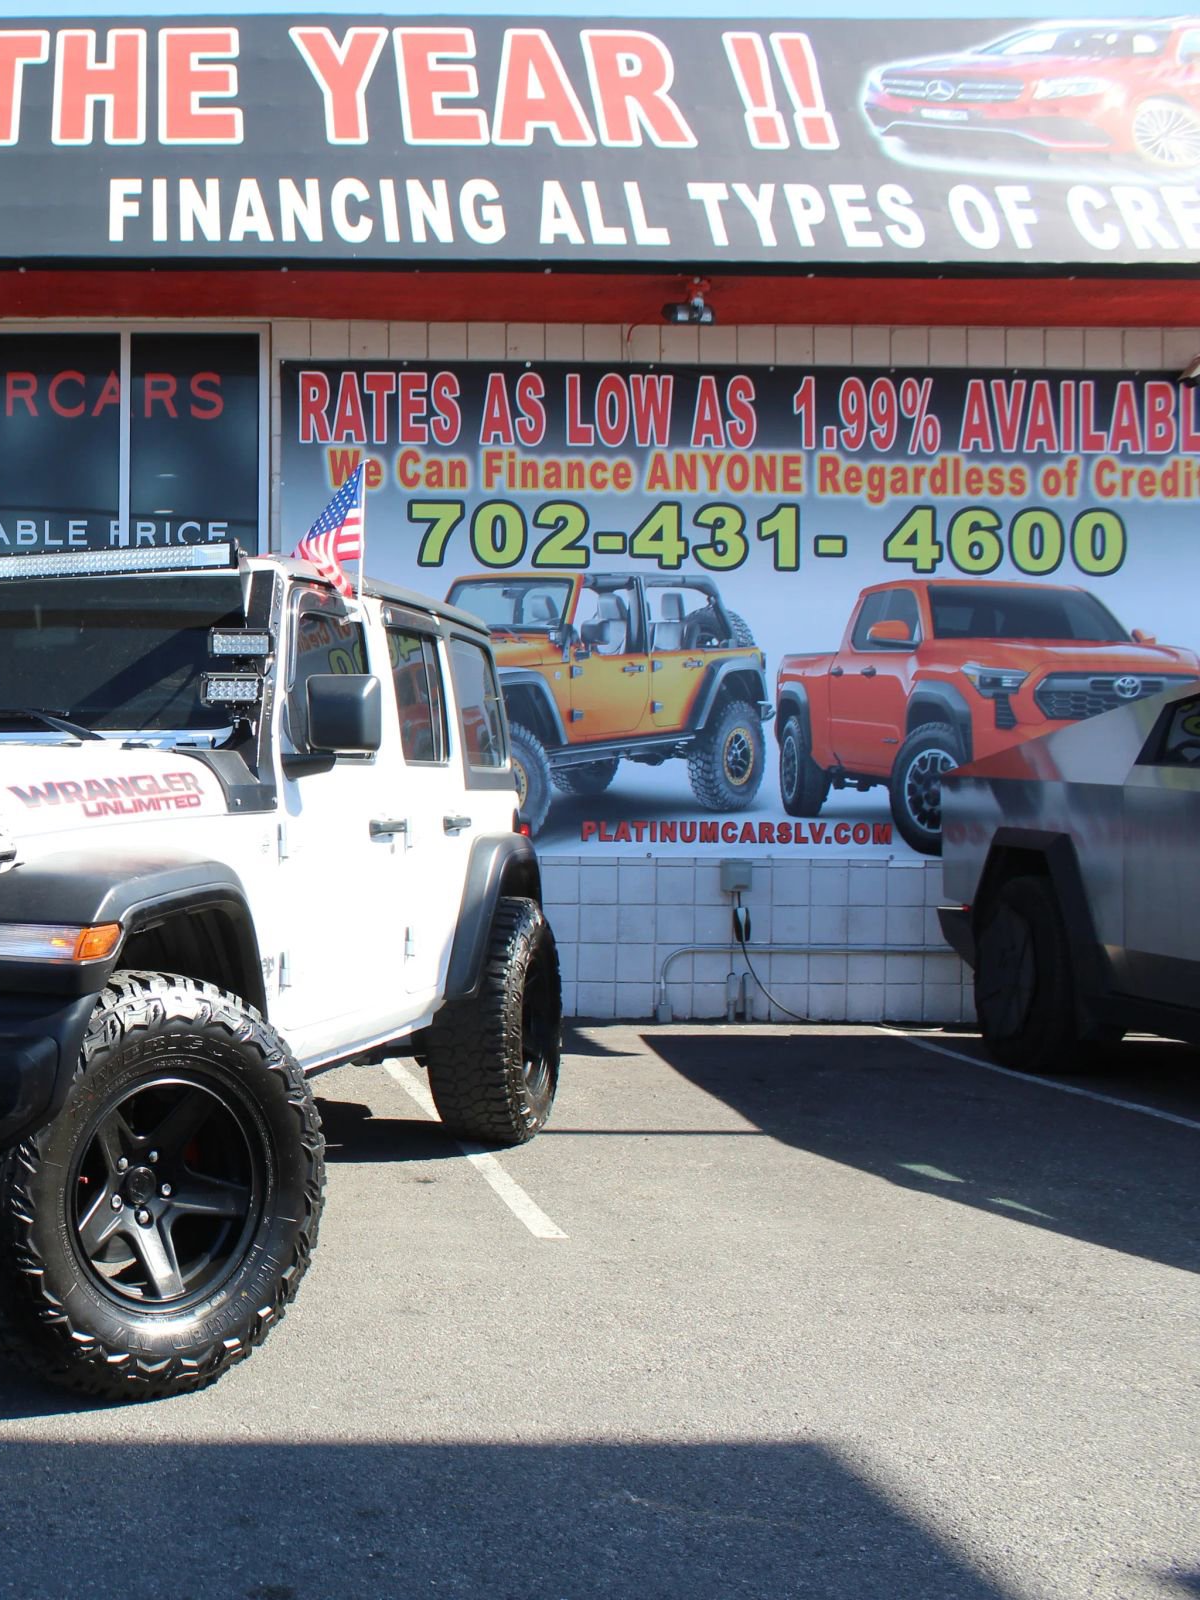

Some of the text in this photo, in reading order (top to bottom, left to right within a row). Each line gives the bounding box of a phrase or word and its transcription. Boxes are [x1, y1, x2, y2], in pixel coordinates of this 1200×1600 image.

[288, 26, 698, 148] YEAR
[721, 31, 841, 151] !!
[109, 178, 1200, 250] FINANCING ALL TYPES OF CRE
[299, 371, 1200, 454] RATES AS LOW AS 1.99% AVAILABL
[328, 449, 1200, 504] We Can Finance ANYONE Regardless of Credi
[407, 499, 1129, 577] 702-431- 4600
[7, 771, 205, 818] WRANGLER UNLIMITED
[580, 820, 893, 845] PLATINUMCARSLV.COM
